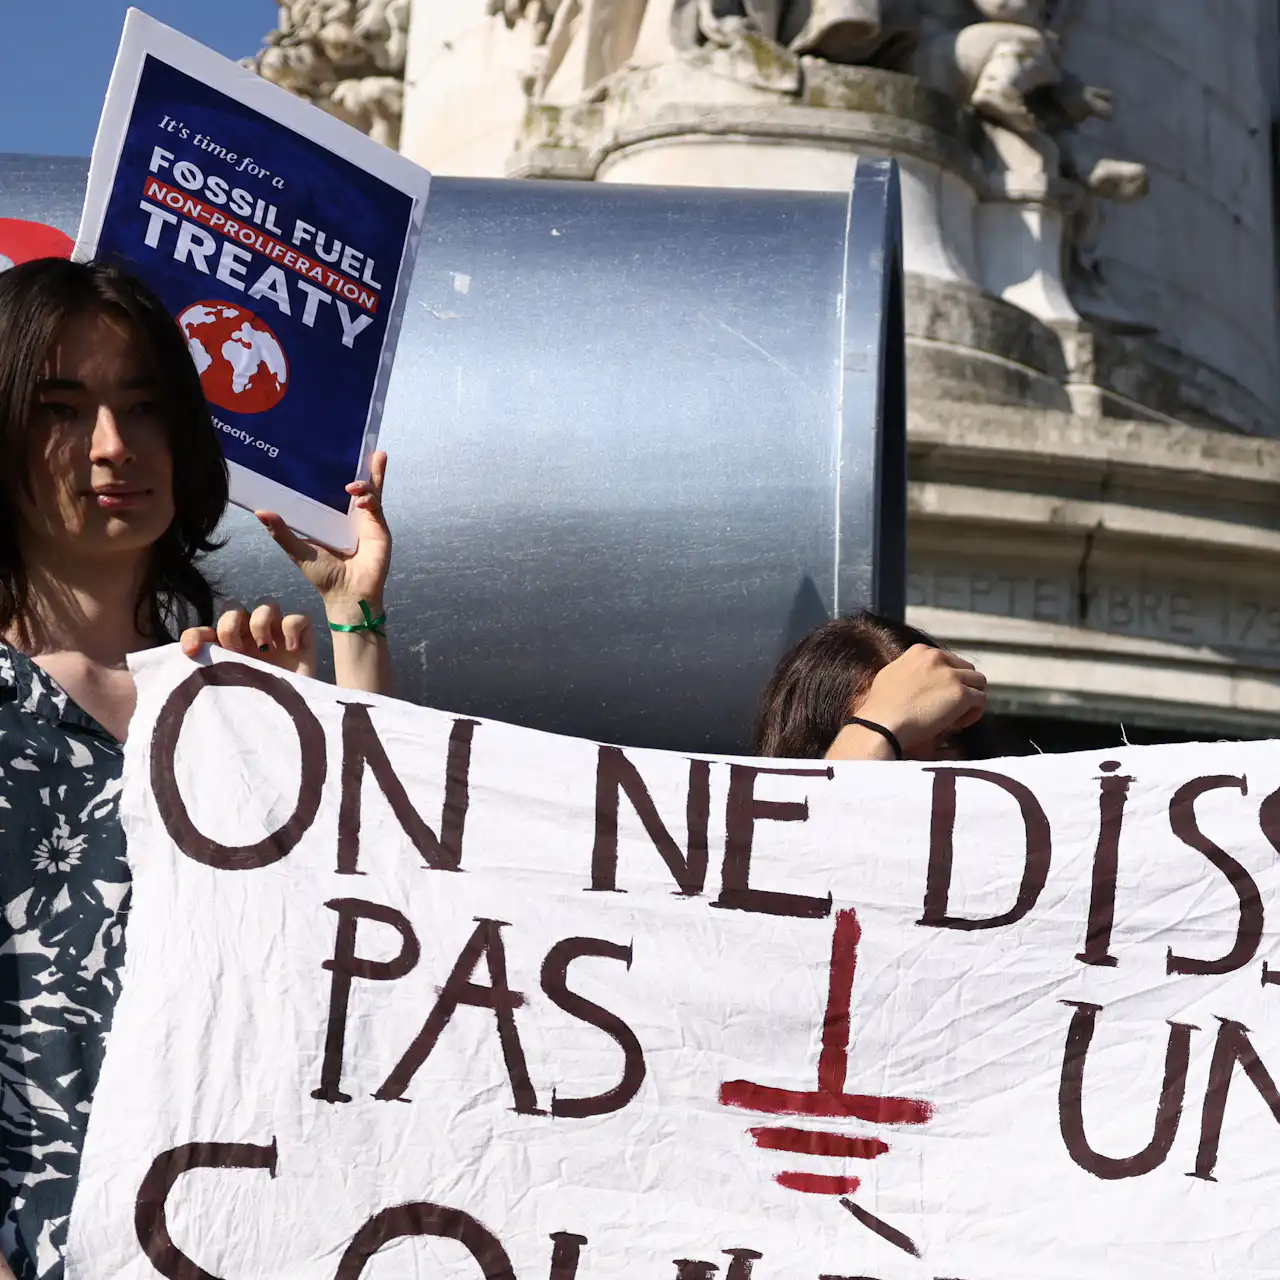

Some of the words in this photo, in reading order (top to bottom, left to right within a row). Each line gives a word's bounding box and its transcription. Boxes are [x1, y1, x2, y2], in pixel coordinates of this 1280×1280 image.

[158, 115, 190, 139] It's
[193, 132, 237, 164] time
[235, 157, 271, 180] for
[272, 176, 285, 190] a
[139, 200, 374, 350] TREATY
[148, 182, 376, 310] NON-PROLIFERATION
[292, 219, 382, 291] FUEL
[211, 416, 280, 458] treaty.org
[150, 660, 483, 876] ON
[581, 744, 835, 919] NE
[310, 897, 647, 1119] PAS
